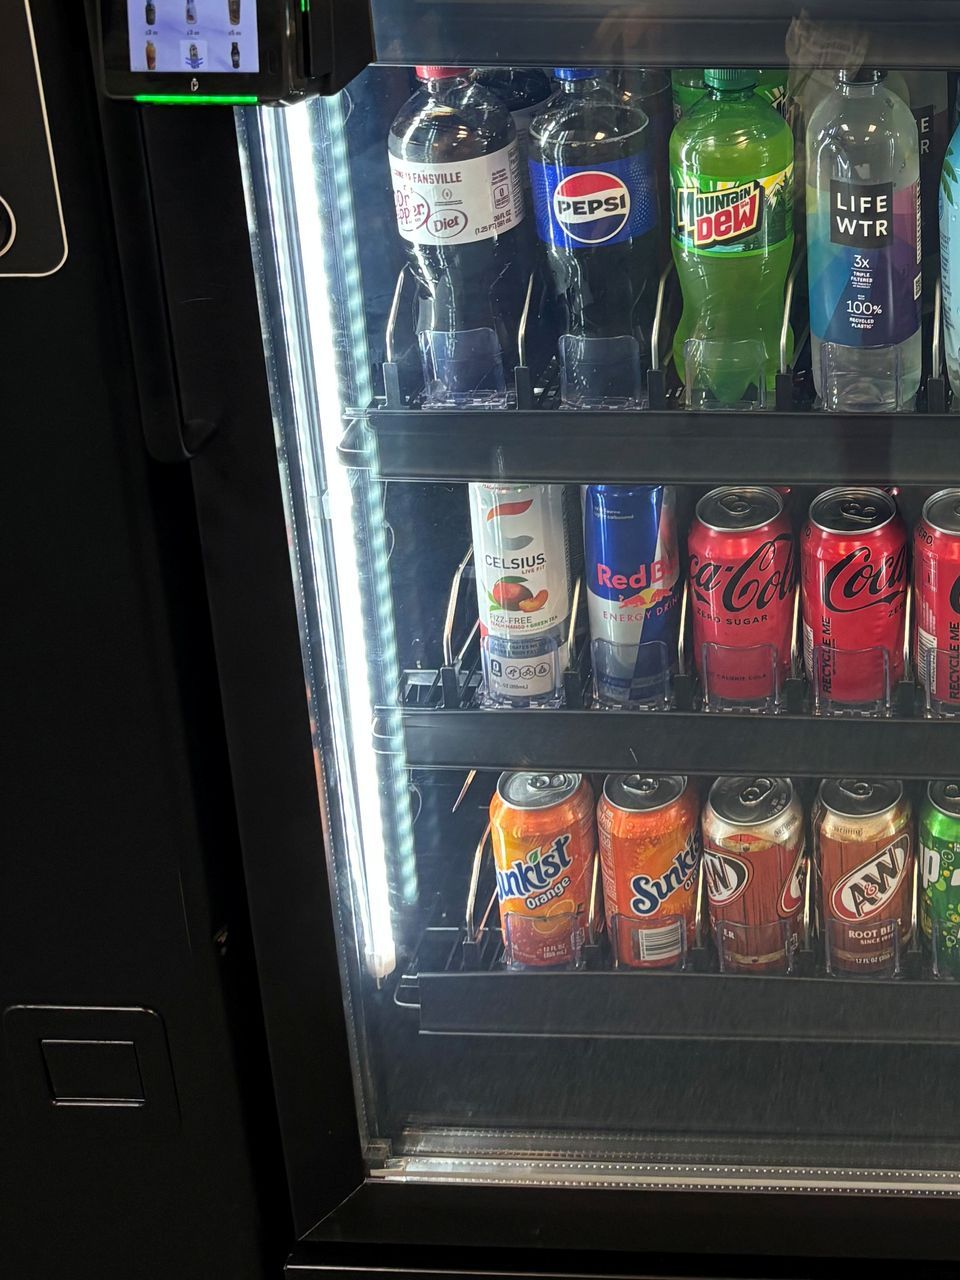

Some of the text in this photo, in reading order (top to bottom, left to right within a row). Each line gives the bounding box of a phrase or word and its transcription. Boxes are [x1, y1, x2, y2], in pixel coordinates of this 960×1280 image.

[413, 172, 463, 185] FANSVILLE
[557, 193, 627, 217] PEPSI
[679, 186, 752, 228] MOUNTAIN
[836, 192, 888, 212] LIFE
[433, 215, 460, 233] Diet
[836, 216, 888, 237] WTR
[853, 254, 870, 269] 3x
[846, 300, 882, 315] 100%
[484, 553, 547, 571] CELSIUS
[596, 563, 646, 590] Red
[603, 610, 652, 622] ENERGY
[725, 613, 769, 626] SUGAR
[822, 615, 833, 694] RECYCLE ME
[950, 621, 960, 700] RECYCLE ME
[848, 846, 901, 919] A&W
[525, 876, 571, 910] Orange
[848, 929, 877, 939] ROOT
